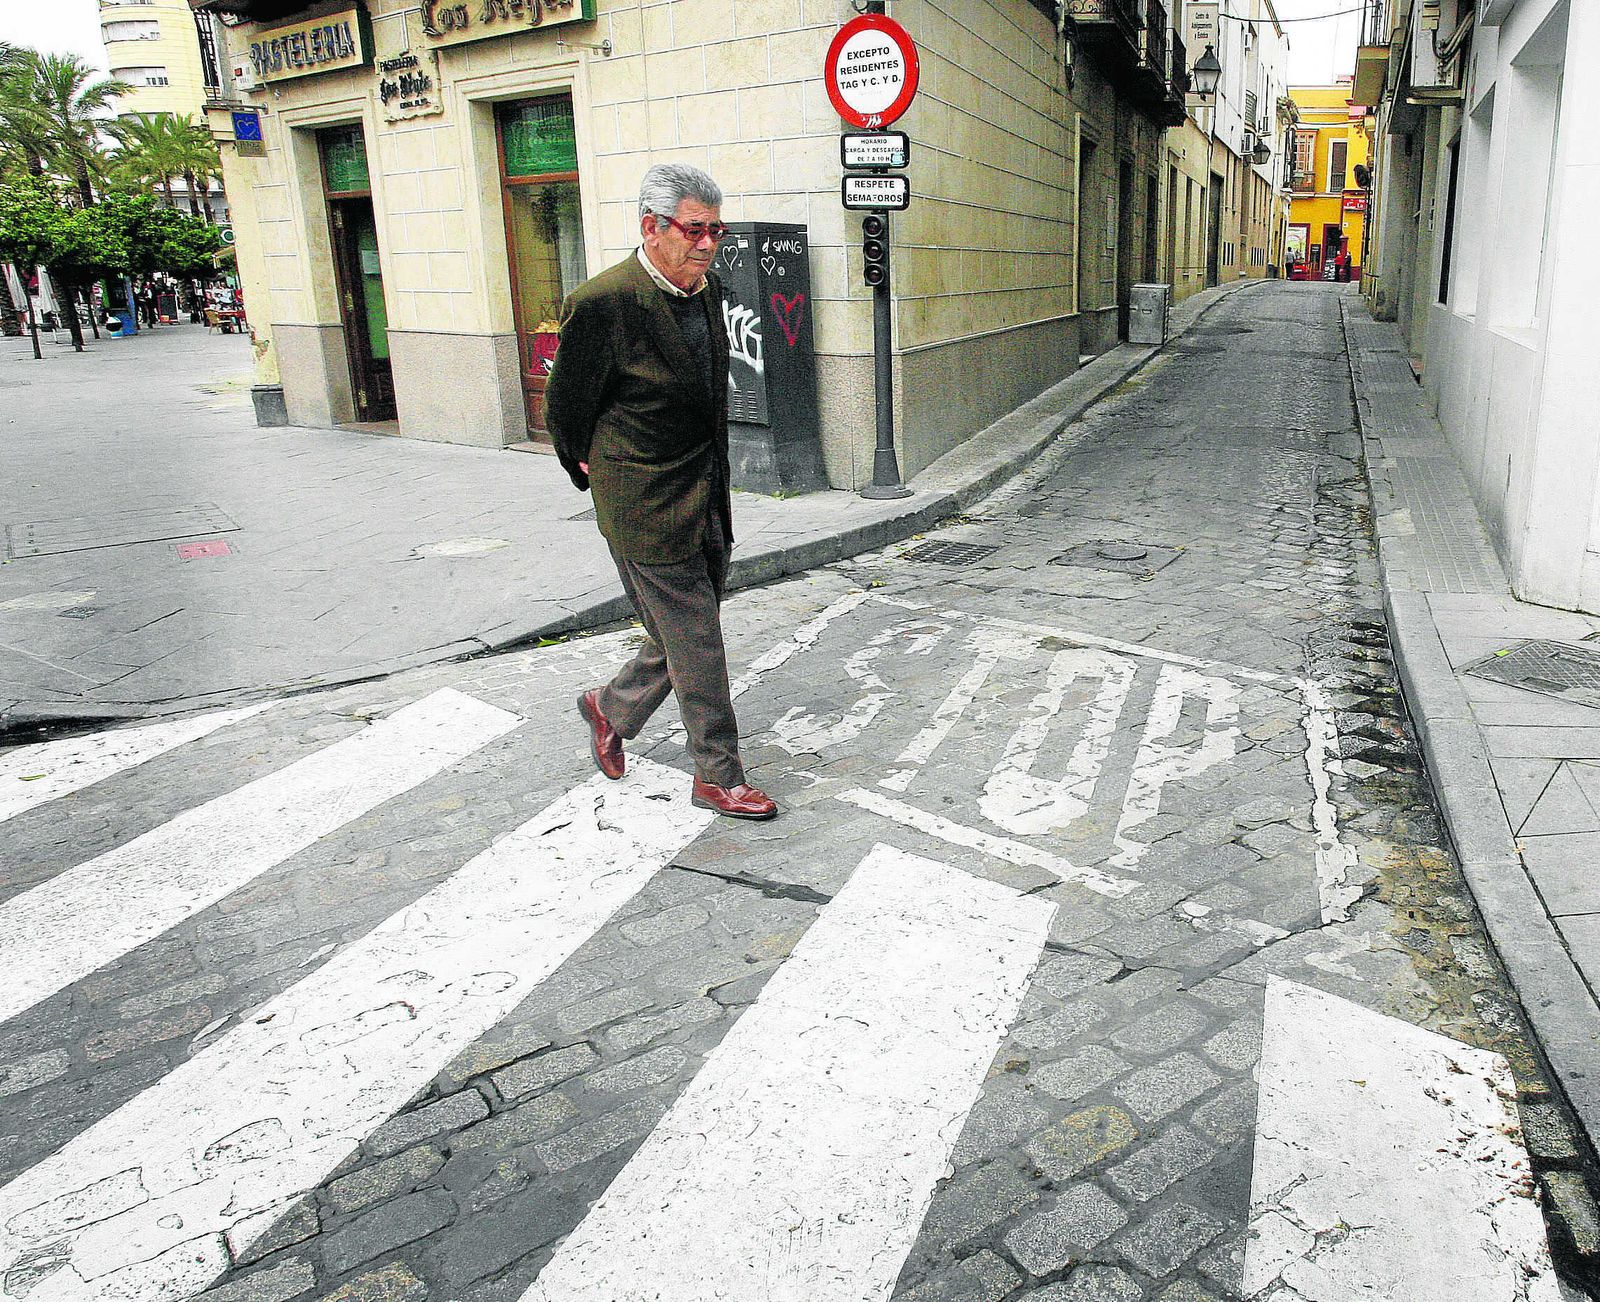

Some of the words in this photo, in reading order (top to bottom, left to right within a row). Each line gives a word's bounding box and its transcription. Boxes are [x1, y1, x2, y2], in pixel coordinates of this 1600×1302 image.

[847, 46, 890, 60] EXCEPTO
[840, 60, 899, 75] RESIDENTES
[840, 80, 859, 89] TAG
[861, 78, 868, 87] Y
[870, 77, 880, 86] C.
[883, 75, 889, 84] Y
[892, 74, 901, 83] D.
[854, 180, 895, 189] RESPETE
[847, 193, 903, 203] SEMAFOROS
